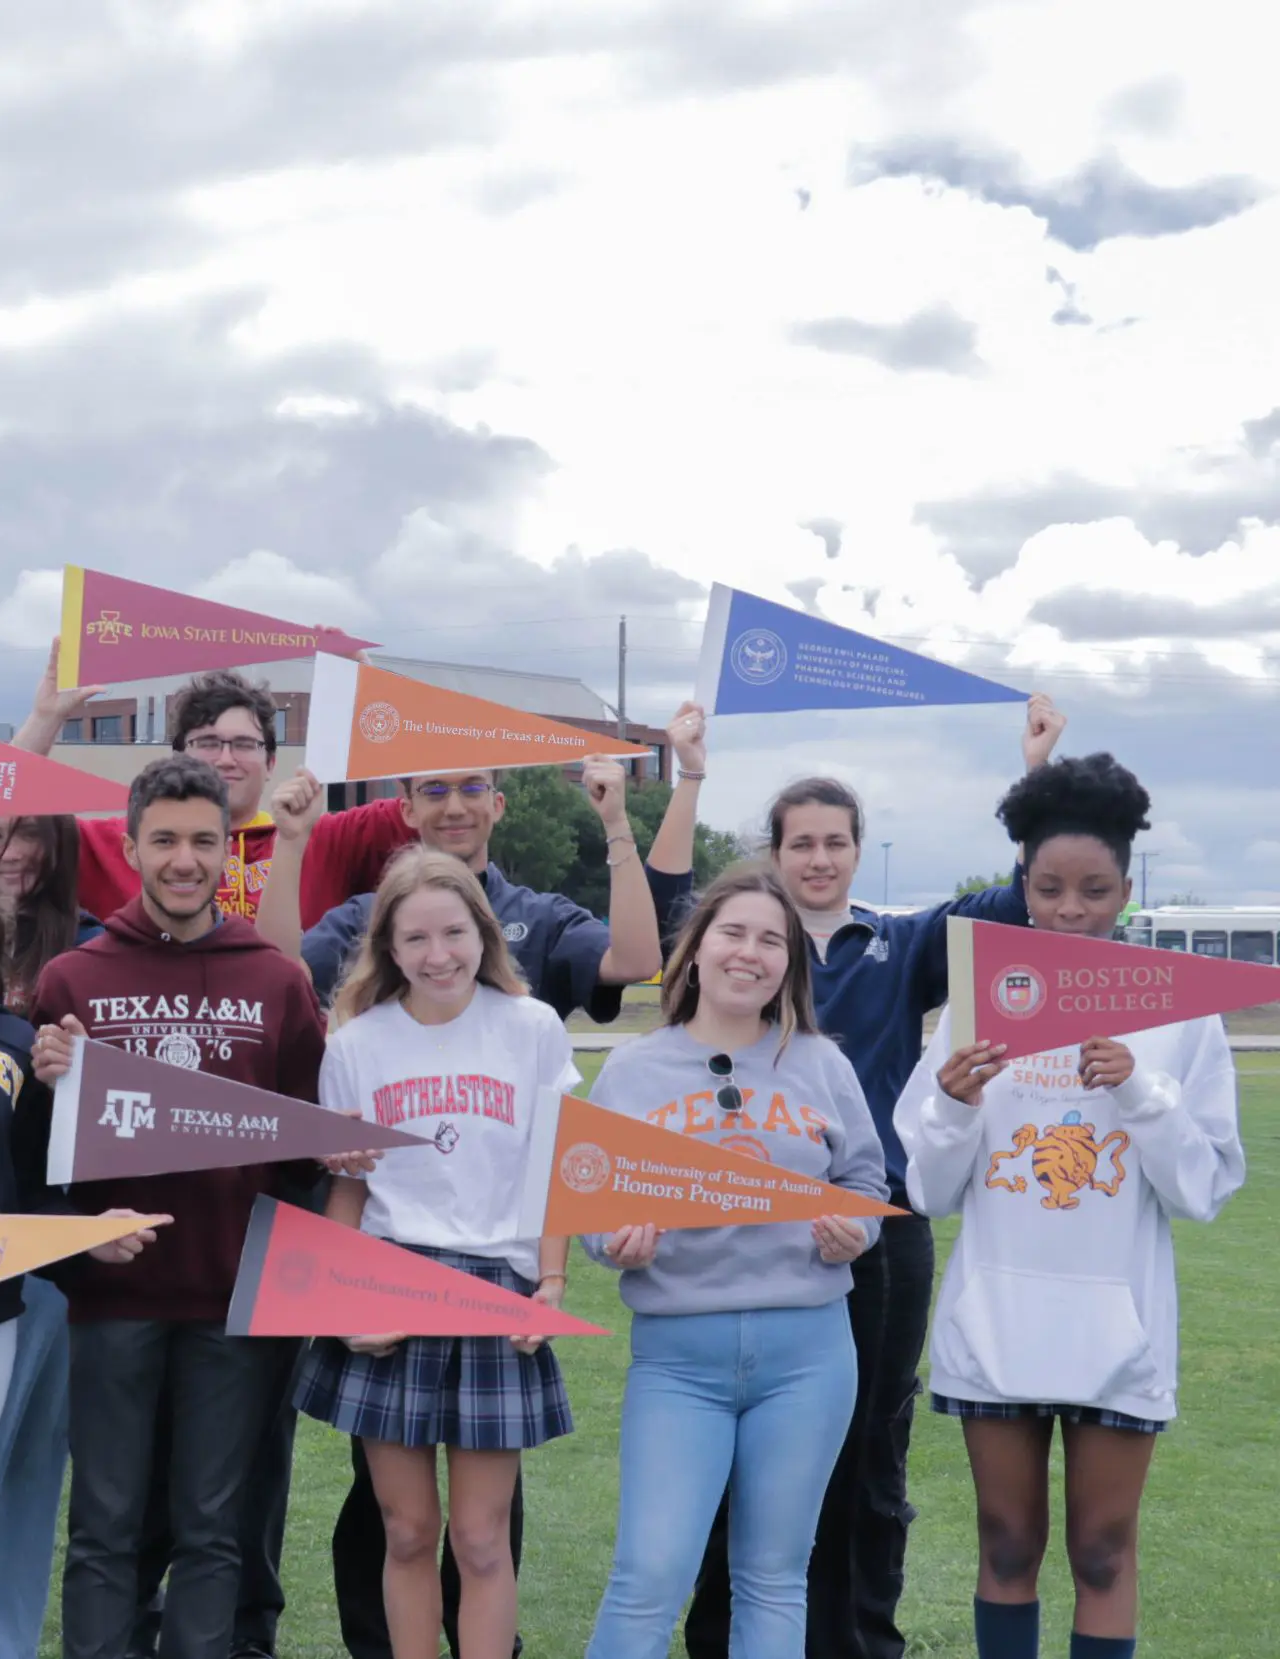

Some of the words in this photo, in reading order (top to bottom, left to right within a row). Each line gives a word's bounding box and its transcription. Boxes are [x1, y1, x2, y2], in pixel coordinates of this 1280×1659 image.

[141, 623, 180, 640] IOWA
[184, 625, 226, 643] STATE
[231, 628, 319, 648] UNIVERSITY
[798, 642, 832, 655] GEORGE
[796, 653, 847, 667] UNIVERSITY
[849, 660, 860, 669] OF
[794, 674, 851, 689] TECHNOLOGY
[887, 678, 906, 687] AND
[403, 719, 423, 732] The
[426, 721, 482, 740] University
[485, 725, 497, 739] of
[500, 728, 532, 742] Texas
[534, 734, 545, 743] at
[548, 735, 585, 747] Austin
[9, 776, 16, 788] 1
[1056, 966, 1175, 989] BOSTON
[88, 994, 189, 1022] TEXAS
[195, 997, 264, 1025] A&M
[1057, 992, 1174, 1013] COLLEGE
[373, 1074, 516, 1128] NORTHEASTERN
[170, 1107, 233, 1128] TEXAS
[237, 1114, 280, 1132] A&M
[170, 1125, 278, 1141] UNIVERSITY
[615, 1155, 638, 1172] The
[640, 1159, 705, 1184] University
[708, 1170, 724, 1183] of
[725, 1170, 761, 1189] Texas
[764, 1176, 777, 1190] at
[779, 1177, 823, 1197] Austin
[612, 1174, 684, 1200] Honors
[688, 1183, 772, 1212] Program
[328, 1266, 438, 1304] Northeastern
[443, 1289, 532, 1322] University
